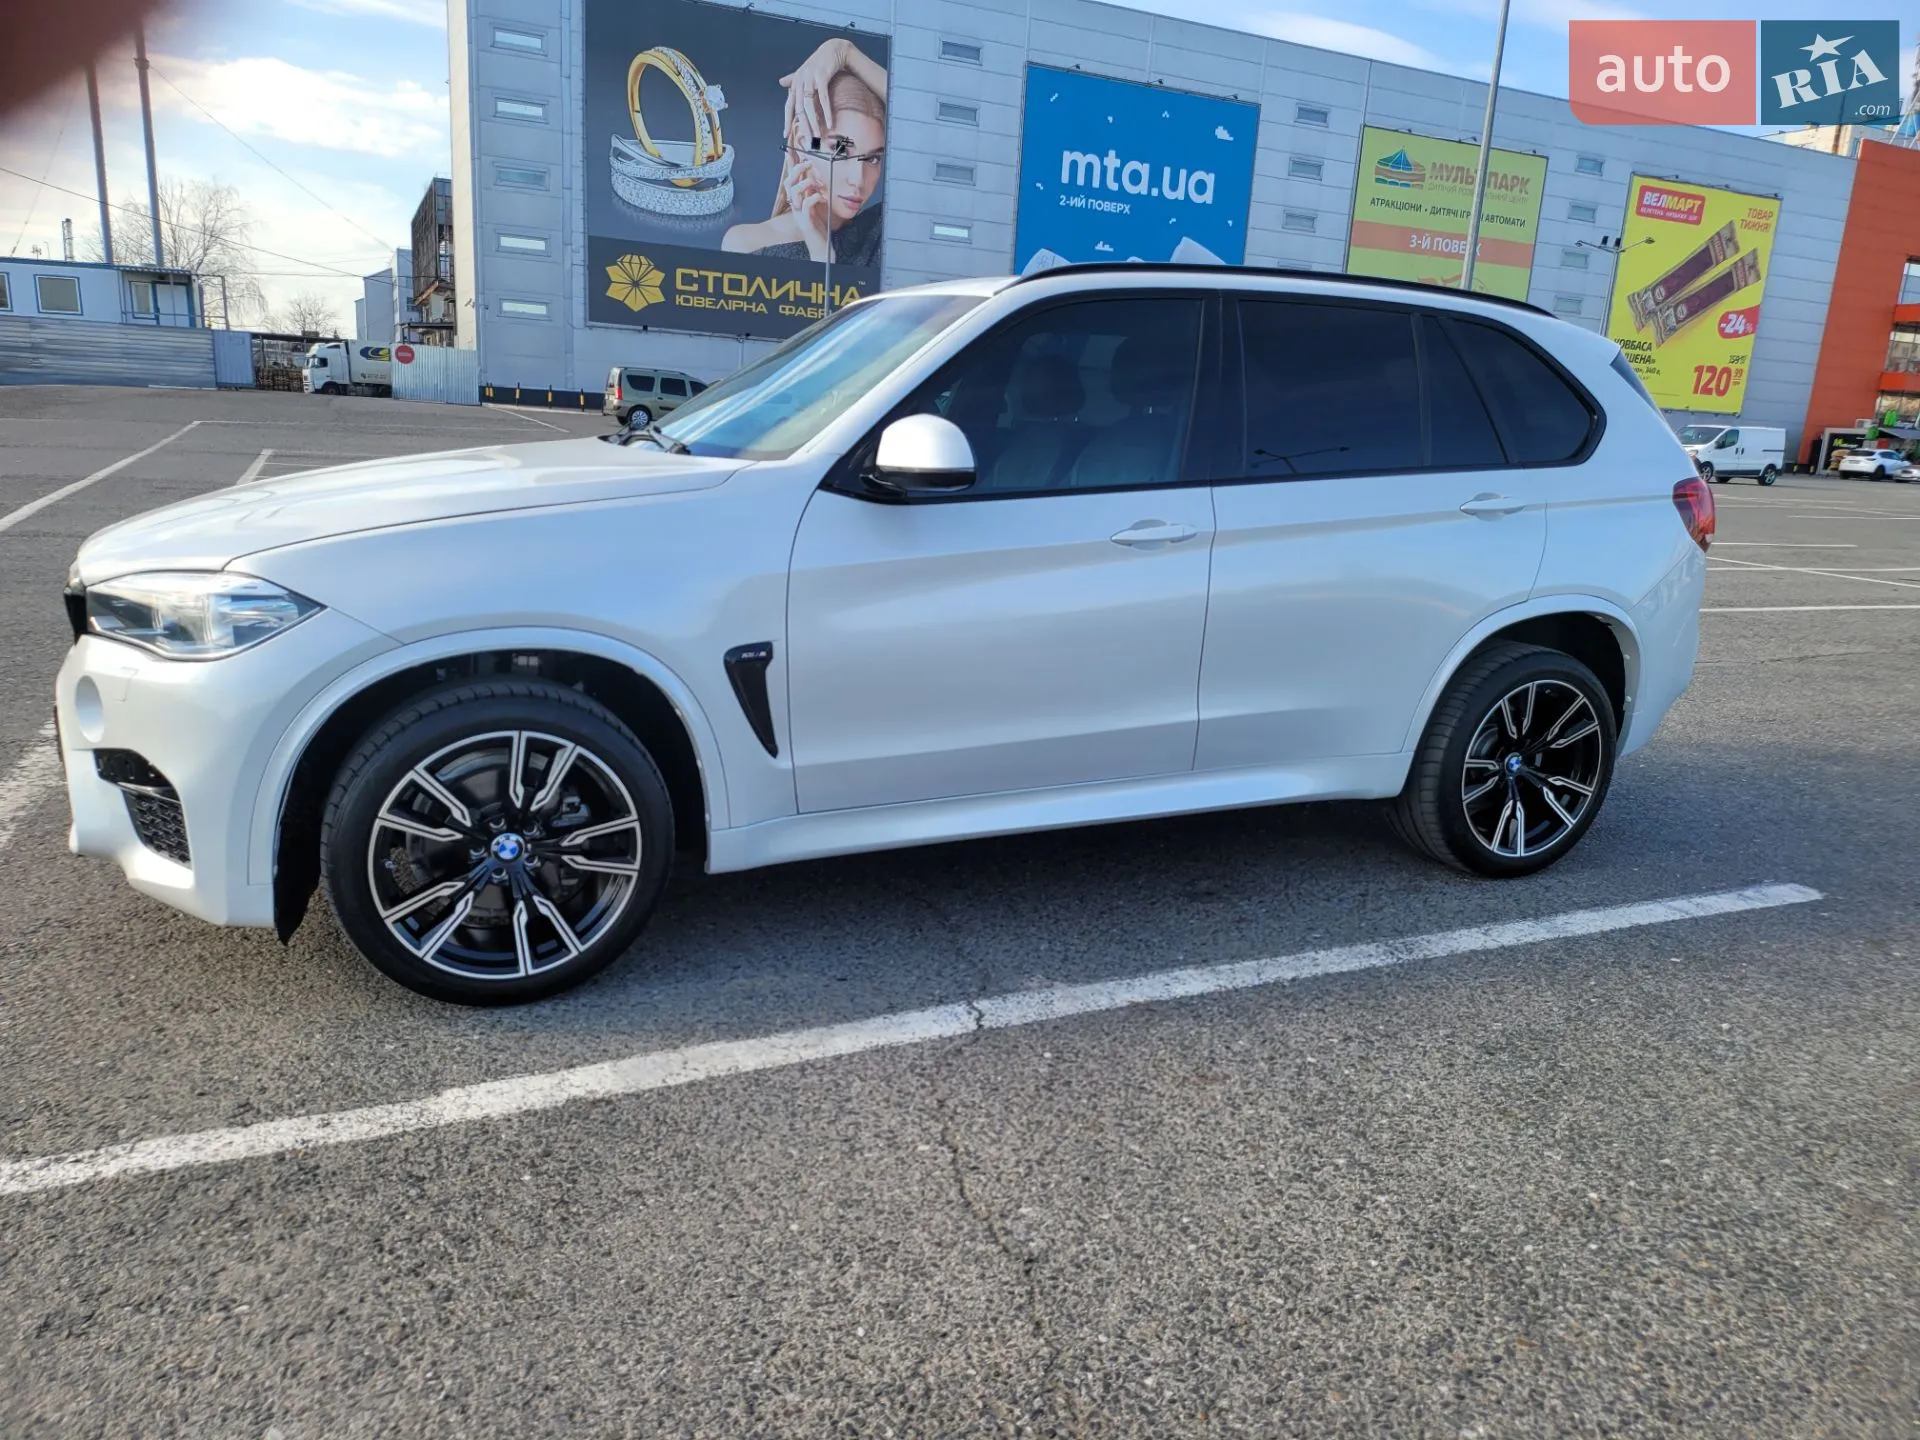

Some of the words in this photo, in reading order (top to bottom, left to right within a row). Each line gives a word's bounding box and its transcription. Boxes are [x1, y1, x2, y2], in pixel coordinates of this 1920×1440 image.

[1061, 149, 1215, 204] mta.ua
[1059, 194, 1086, 209] 2-ИЙ
[1087, 198, 1131, 215] ПОВЕРХ
[1370, 197, 1422, 213] АТРАКЦІОНИ
[1484, 214, 1526, 228] АВТОМАТИ
[1642, 191, 1702, 213] ВЕЛМАРТ
[1409, 233, 1431, 250] 3-Й
[675, 267, 861, 307] СТОЛИЧНА
[675, 295, 769, 315] ЮВЕЛІРНА
[1692, 365, 1732, 397] 120
